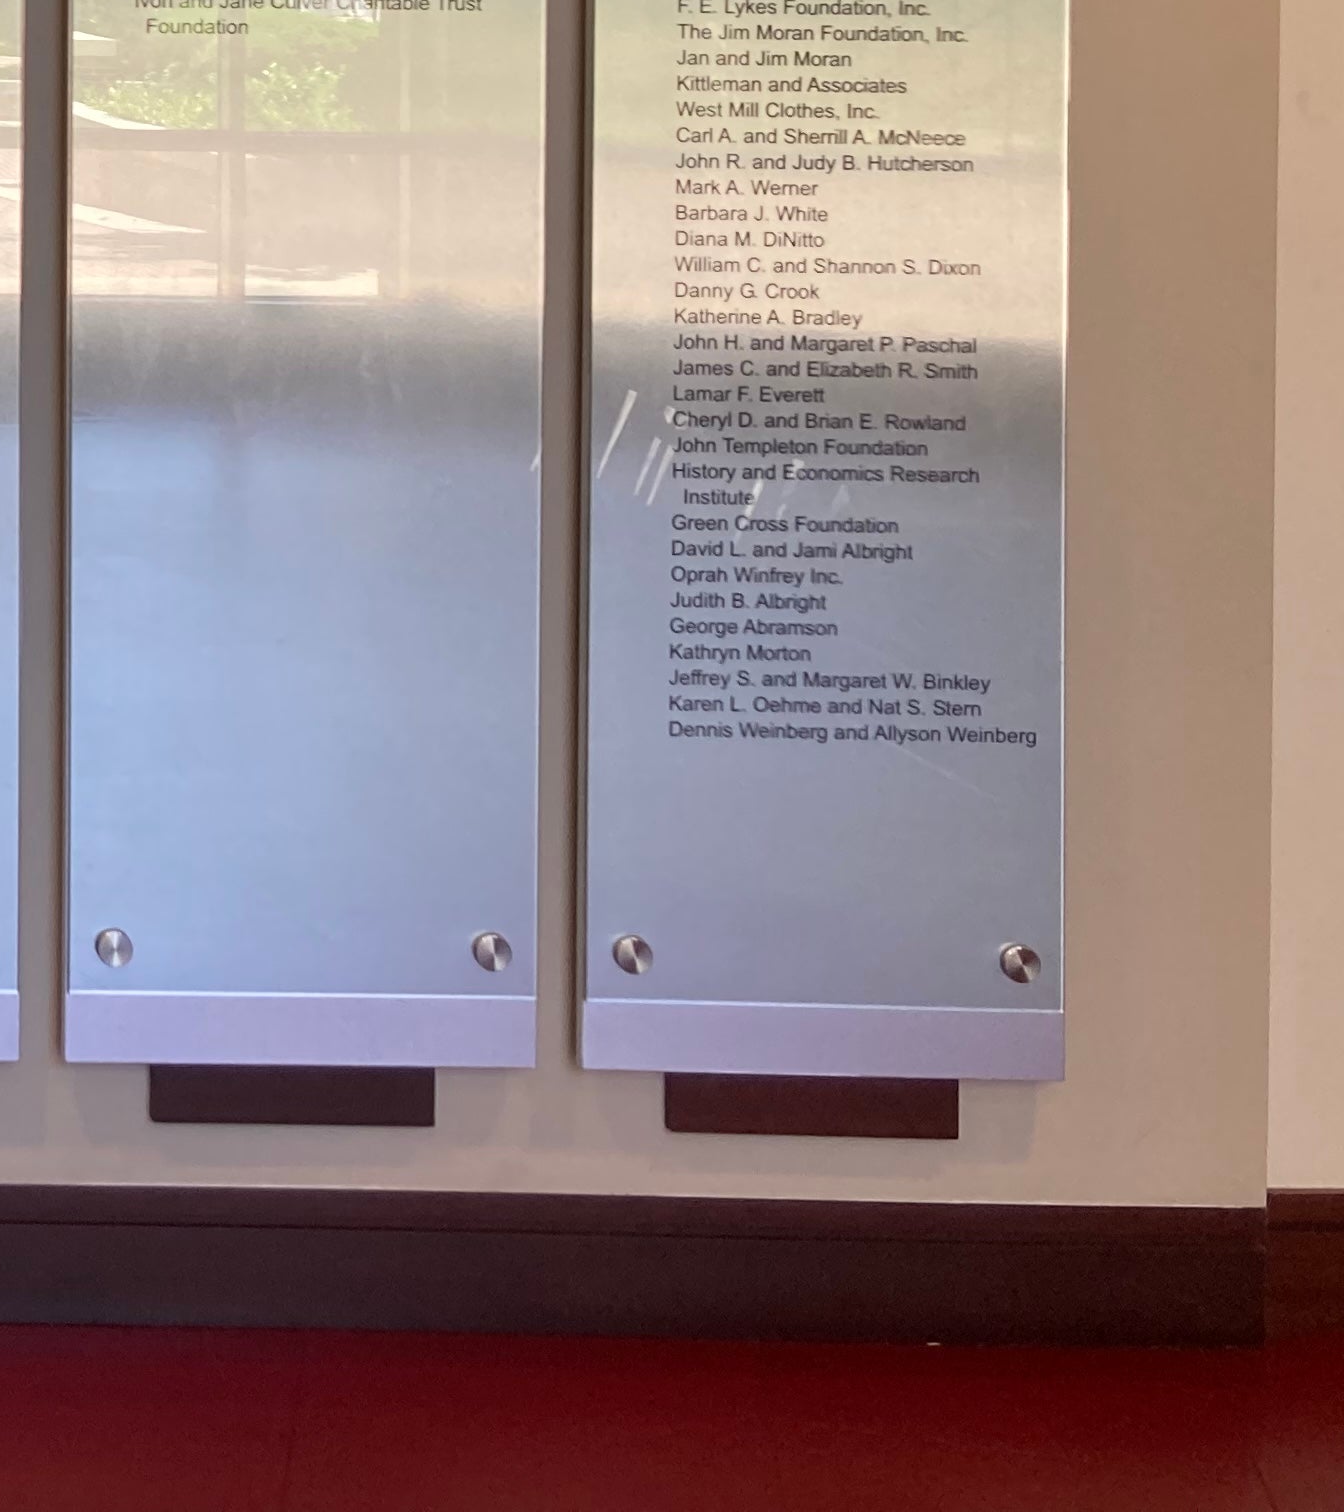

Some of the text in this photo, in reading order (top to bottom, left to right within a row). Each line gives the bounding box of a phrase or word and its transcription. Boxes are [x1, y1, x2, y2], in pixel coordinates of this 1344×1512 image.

[677, 75, 908, 94] Kittleman and Associates
[675, 204, 828, 222] Barbara J. White
[668, 720, 1037, 748] Dennis Weinberg and Allyson Weinberg
